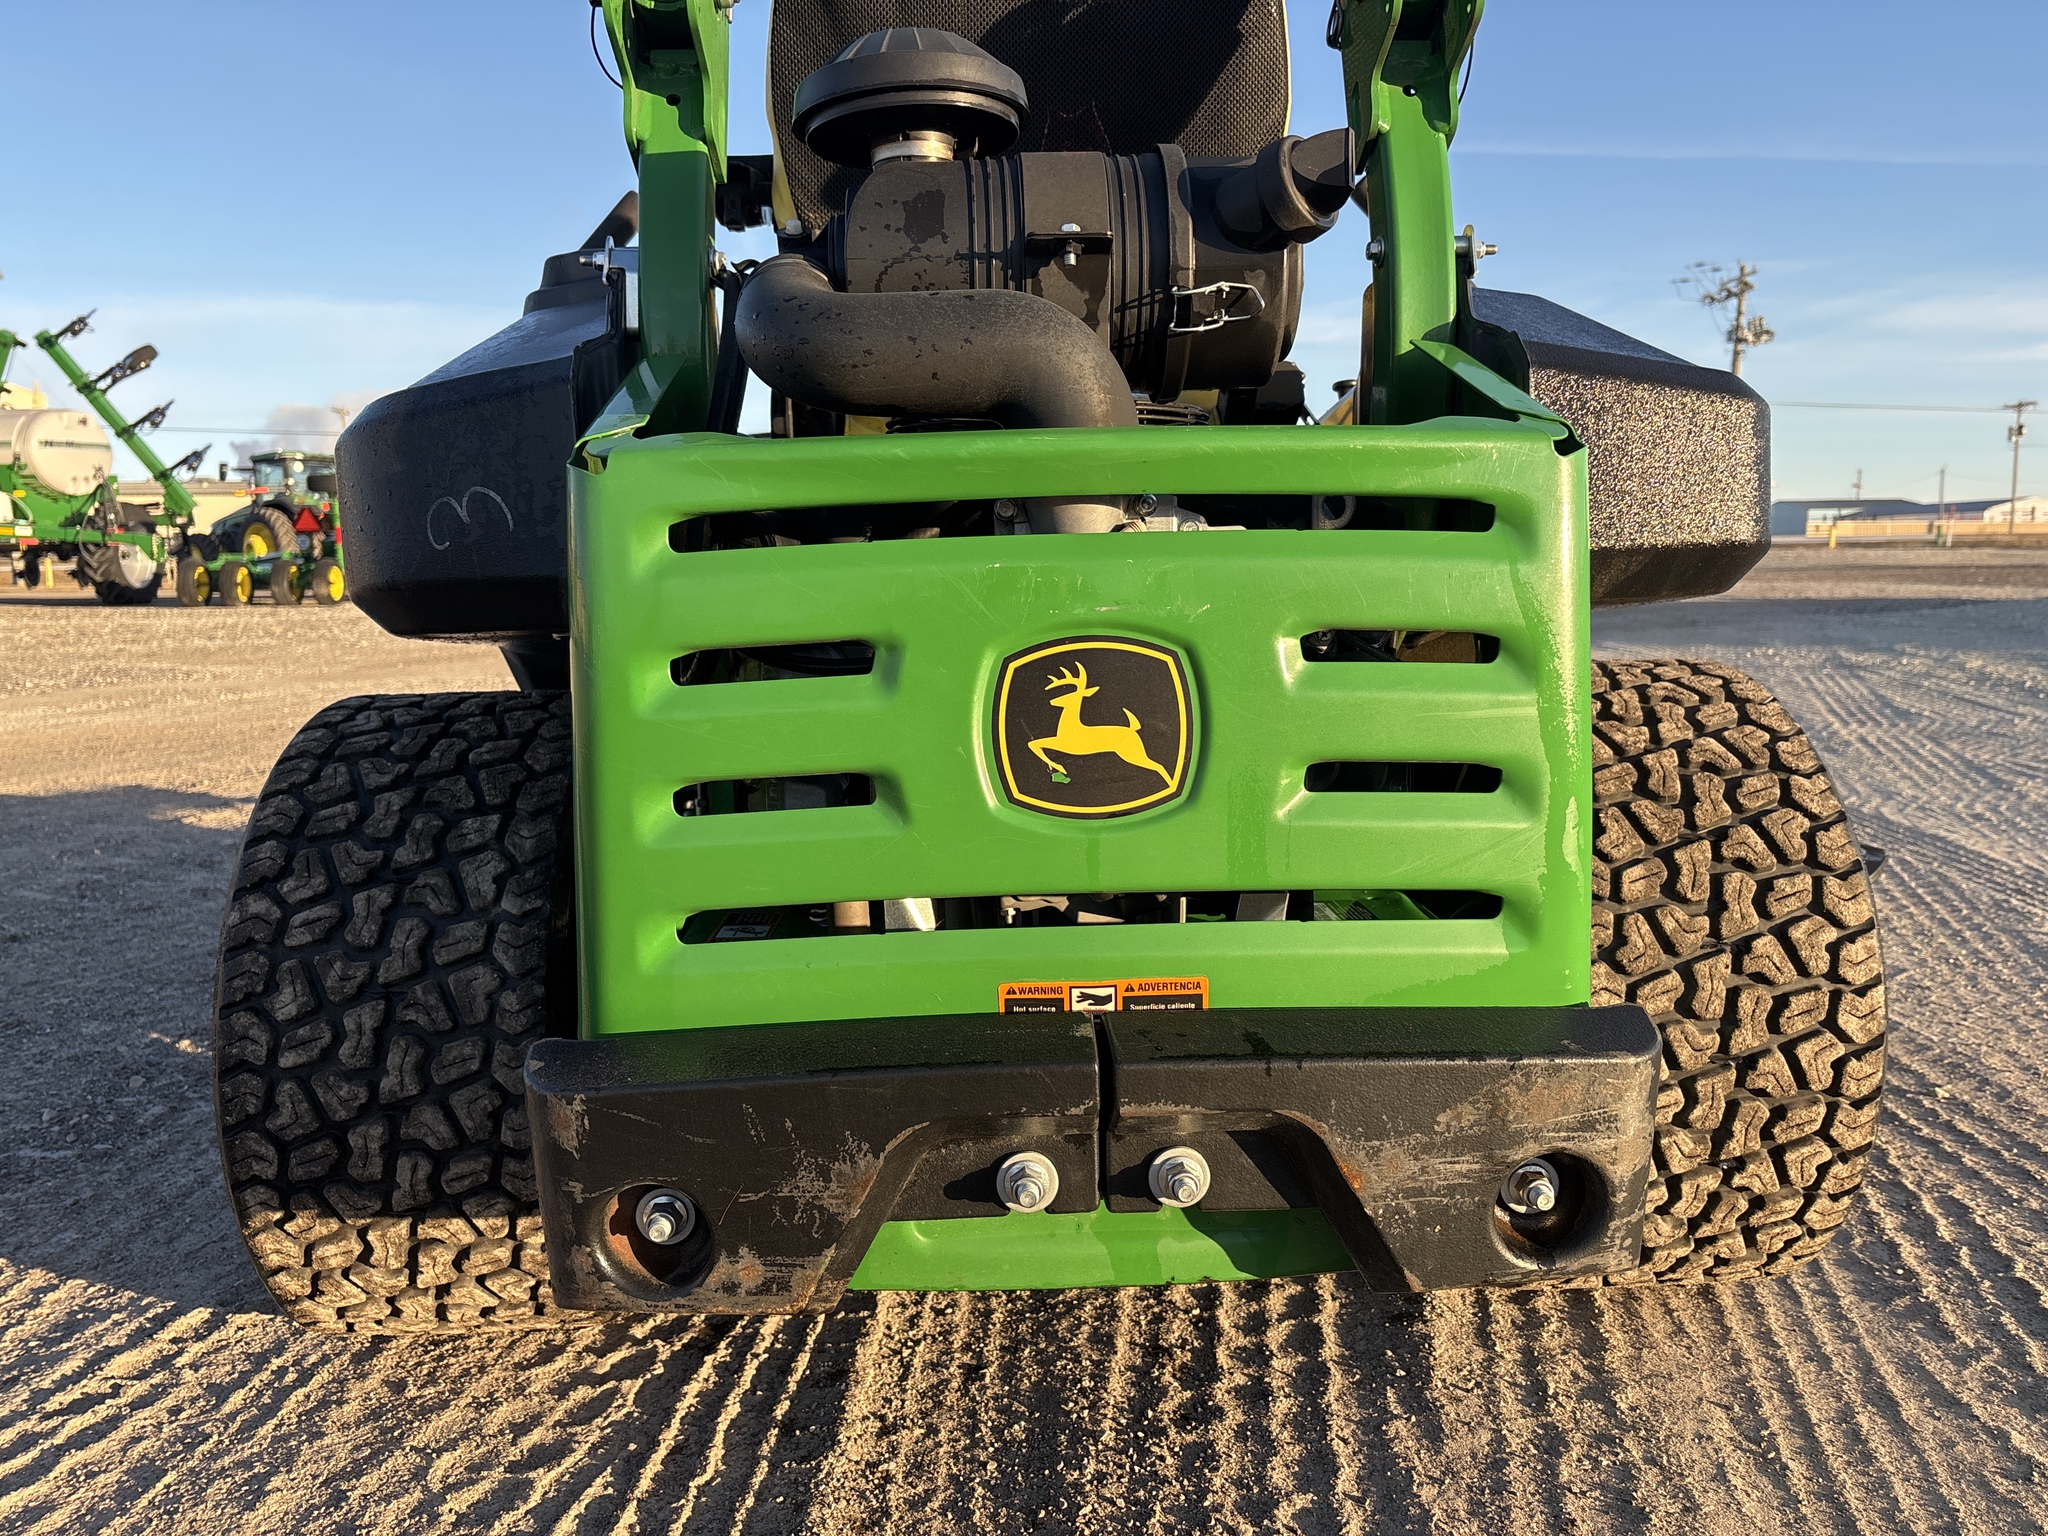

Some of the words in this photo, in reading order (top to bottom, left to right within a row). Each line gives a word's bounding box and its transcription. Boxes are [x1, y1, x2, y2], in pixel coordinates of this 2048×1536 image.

[1017, 986, 1063, 996] WARNING
[1137, 981, 1202, 992] ADVERTENCIA
[1013, 1005, 1027, 1013] Hot
[1028, 1005, 1057, 1013] surface
[1129, 1003, 1166, 1011] Superficie
[1167, 1002, 1197, 1010] caliente
